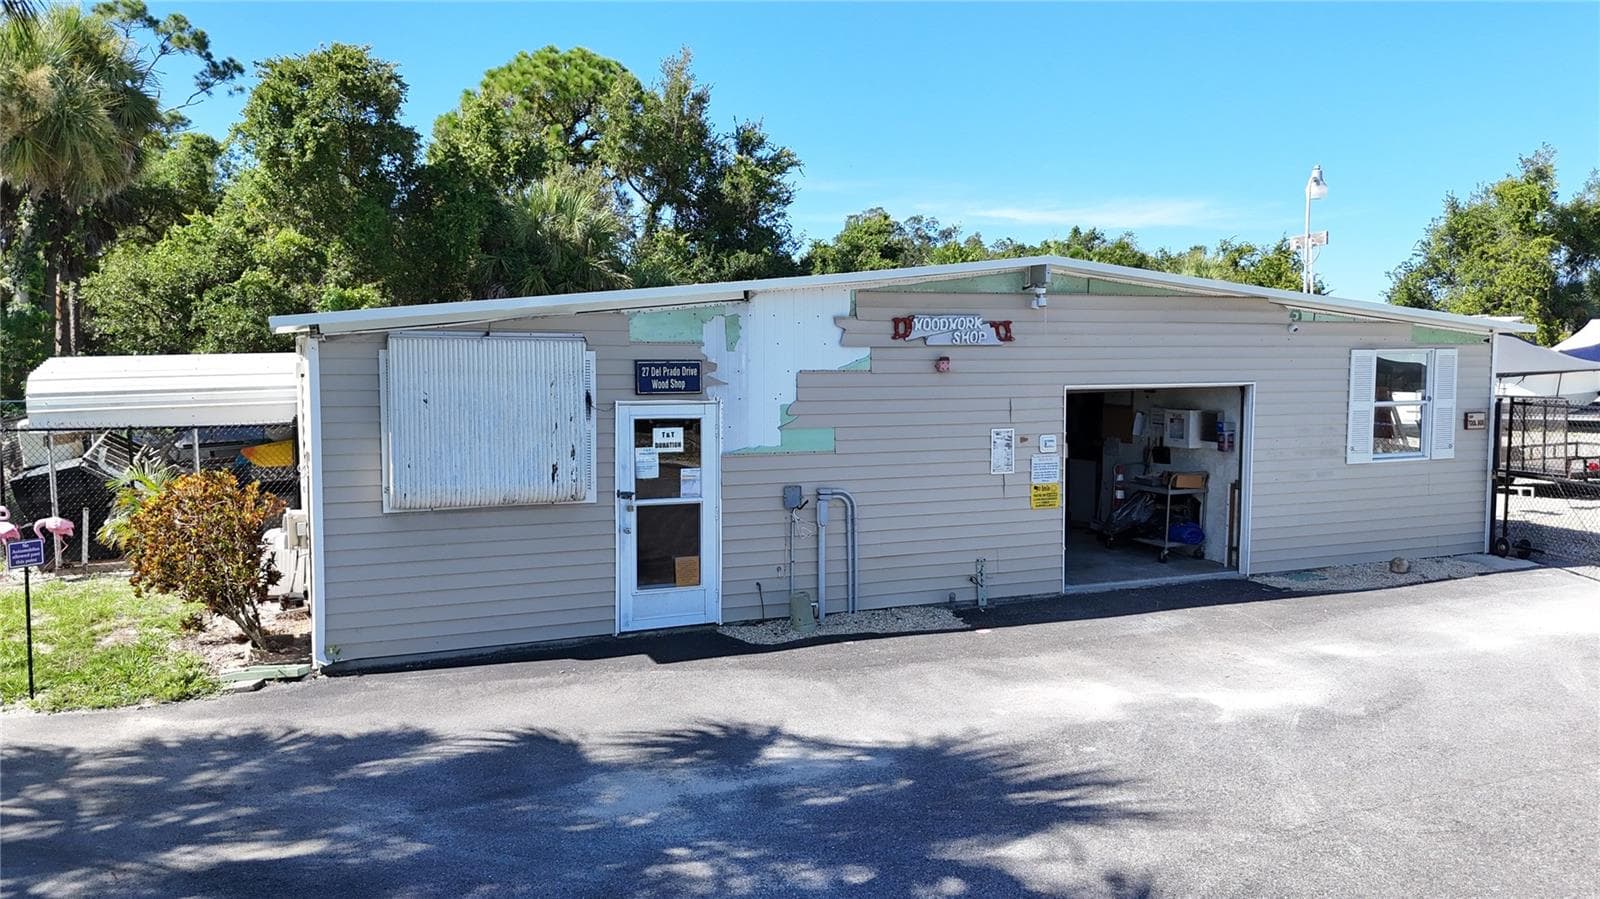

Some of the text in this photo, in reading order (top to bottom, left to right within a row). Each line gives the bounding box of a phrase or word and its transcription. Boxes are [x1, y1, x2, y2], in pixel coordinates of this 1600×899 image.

[913, 317, 982, 331] WOODWORK
[952, 331, 987, 344] SHOP
[641, 366, 698, 377] 27 Del Prado Drive
[651, 379, 686, 390] Wood Shop
